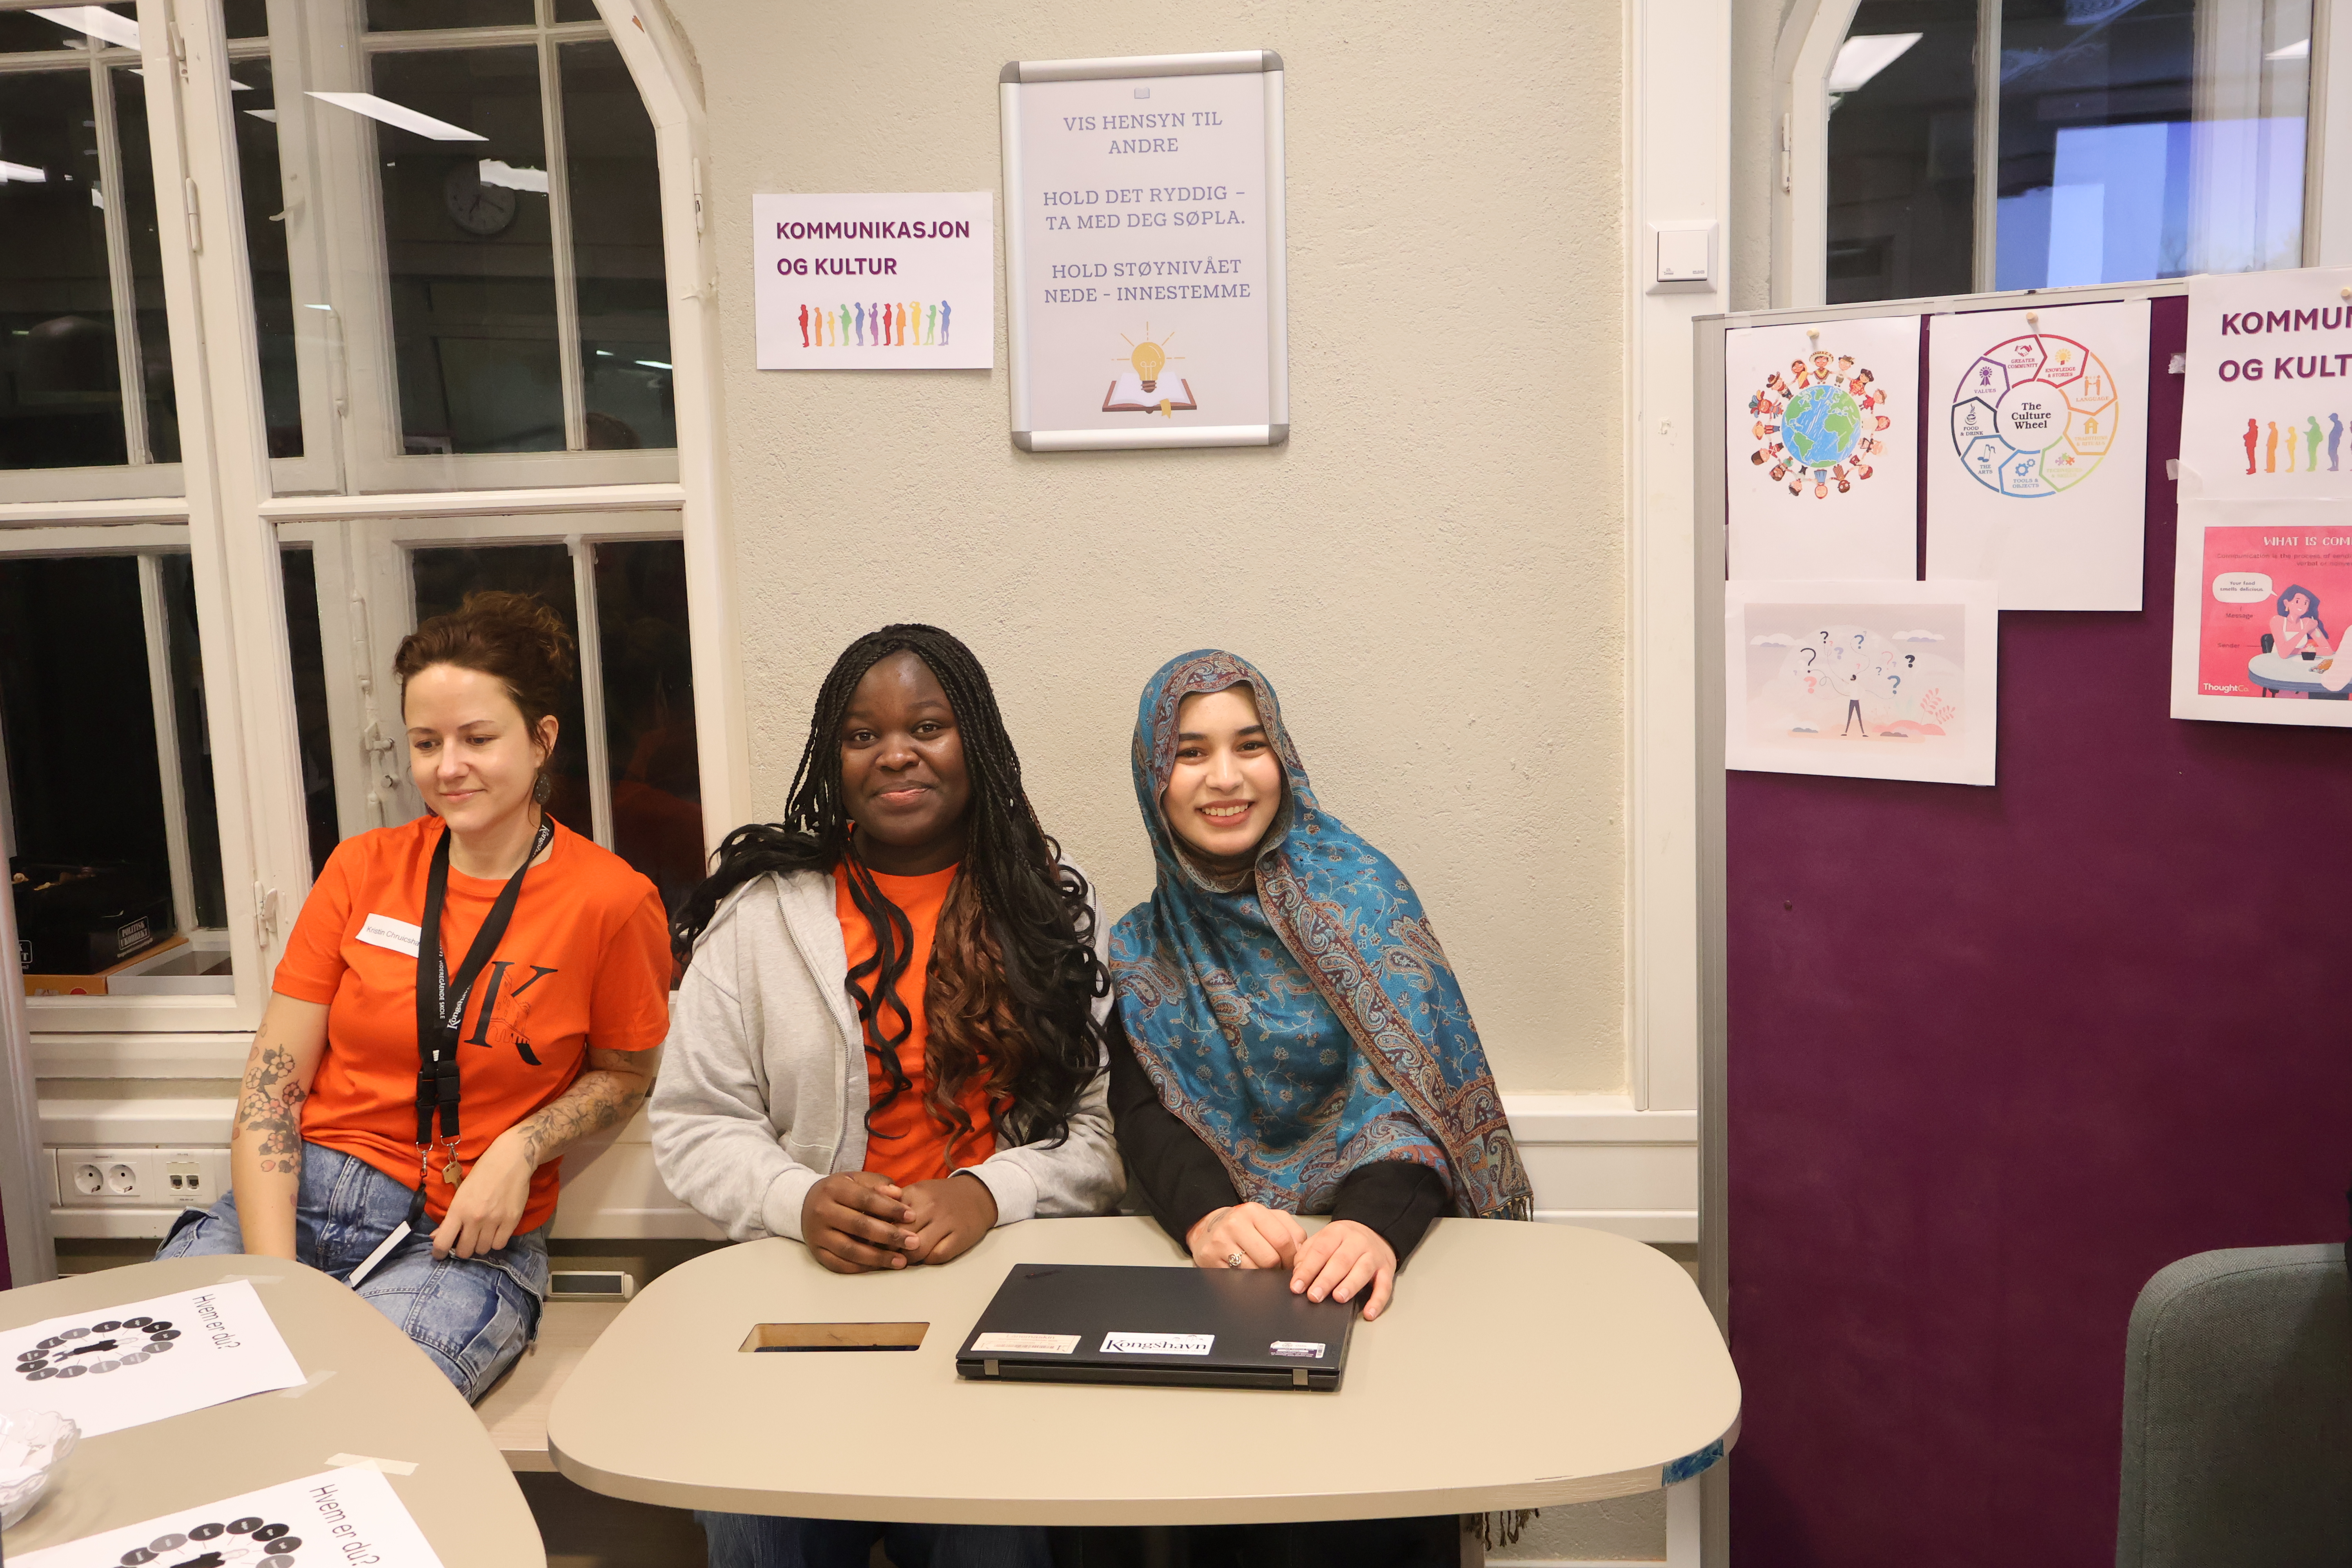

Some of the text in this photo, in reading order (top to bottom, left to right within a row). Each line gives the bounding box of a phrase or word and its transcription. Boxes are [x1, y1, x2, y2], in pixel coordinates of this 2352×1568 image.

[1063, 112, 1223, 131] VIS HENSYN TIL
[1108, 138, 1179, 154] ANDRE
[1044, 190, 1099, 206] HOLD
[1105, 189, 1143, 204] DET
[1150, 186, 1227, 202] RYDDIG
[1046, 211, 1245, 230] TA MED DEG SØPLA.
[777, 221, 969, 240] KOMMUNIKASJON
[777, 258, 897, 276] OG KULTUR
[1052, 256, 1241, 279] HOLD STØYNIVÅET
[1045, 289, 1097, 303] NEDE
[1117, 284, 1251, 301] INNESTEMME
[2222, 306, 2352, 336] KOMMU
[2219, 358, 2263, 382] OG
[2011, 412, 2051, 420] Culture
[2015, 420, 2047, 429] Wheel
[2264, 536, 2299, 546] WHAT
[2305, 537, 2317, 546] IS
[366, 926, 385, 936] Kristin
[192, 1294, 241, 1349] Hvem er du?
[1105, 1339, 1206, 1352] Kongshavn
[309, 1484, 380, 1566] Hvem er du?
